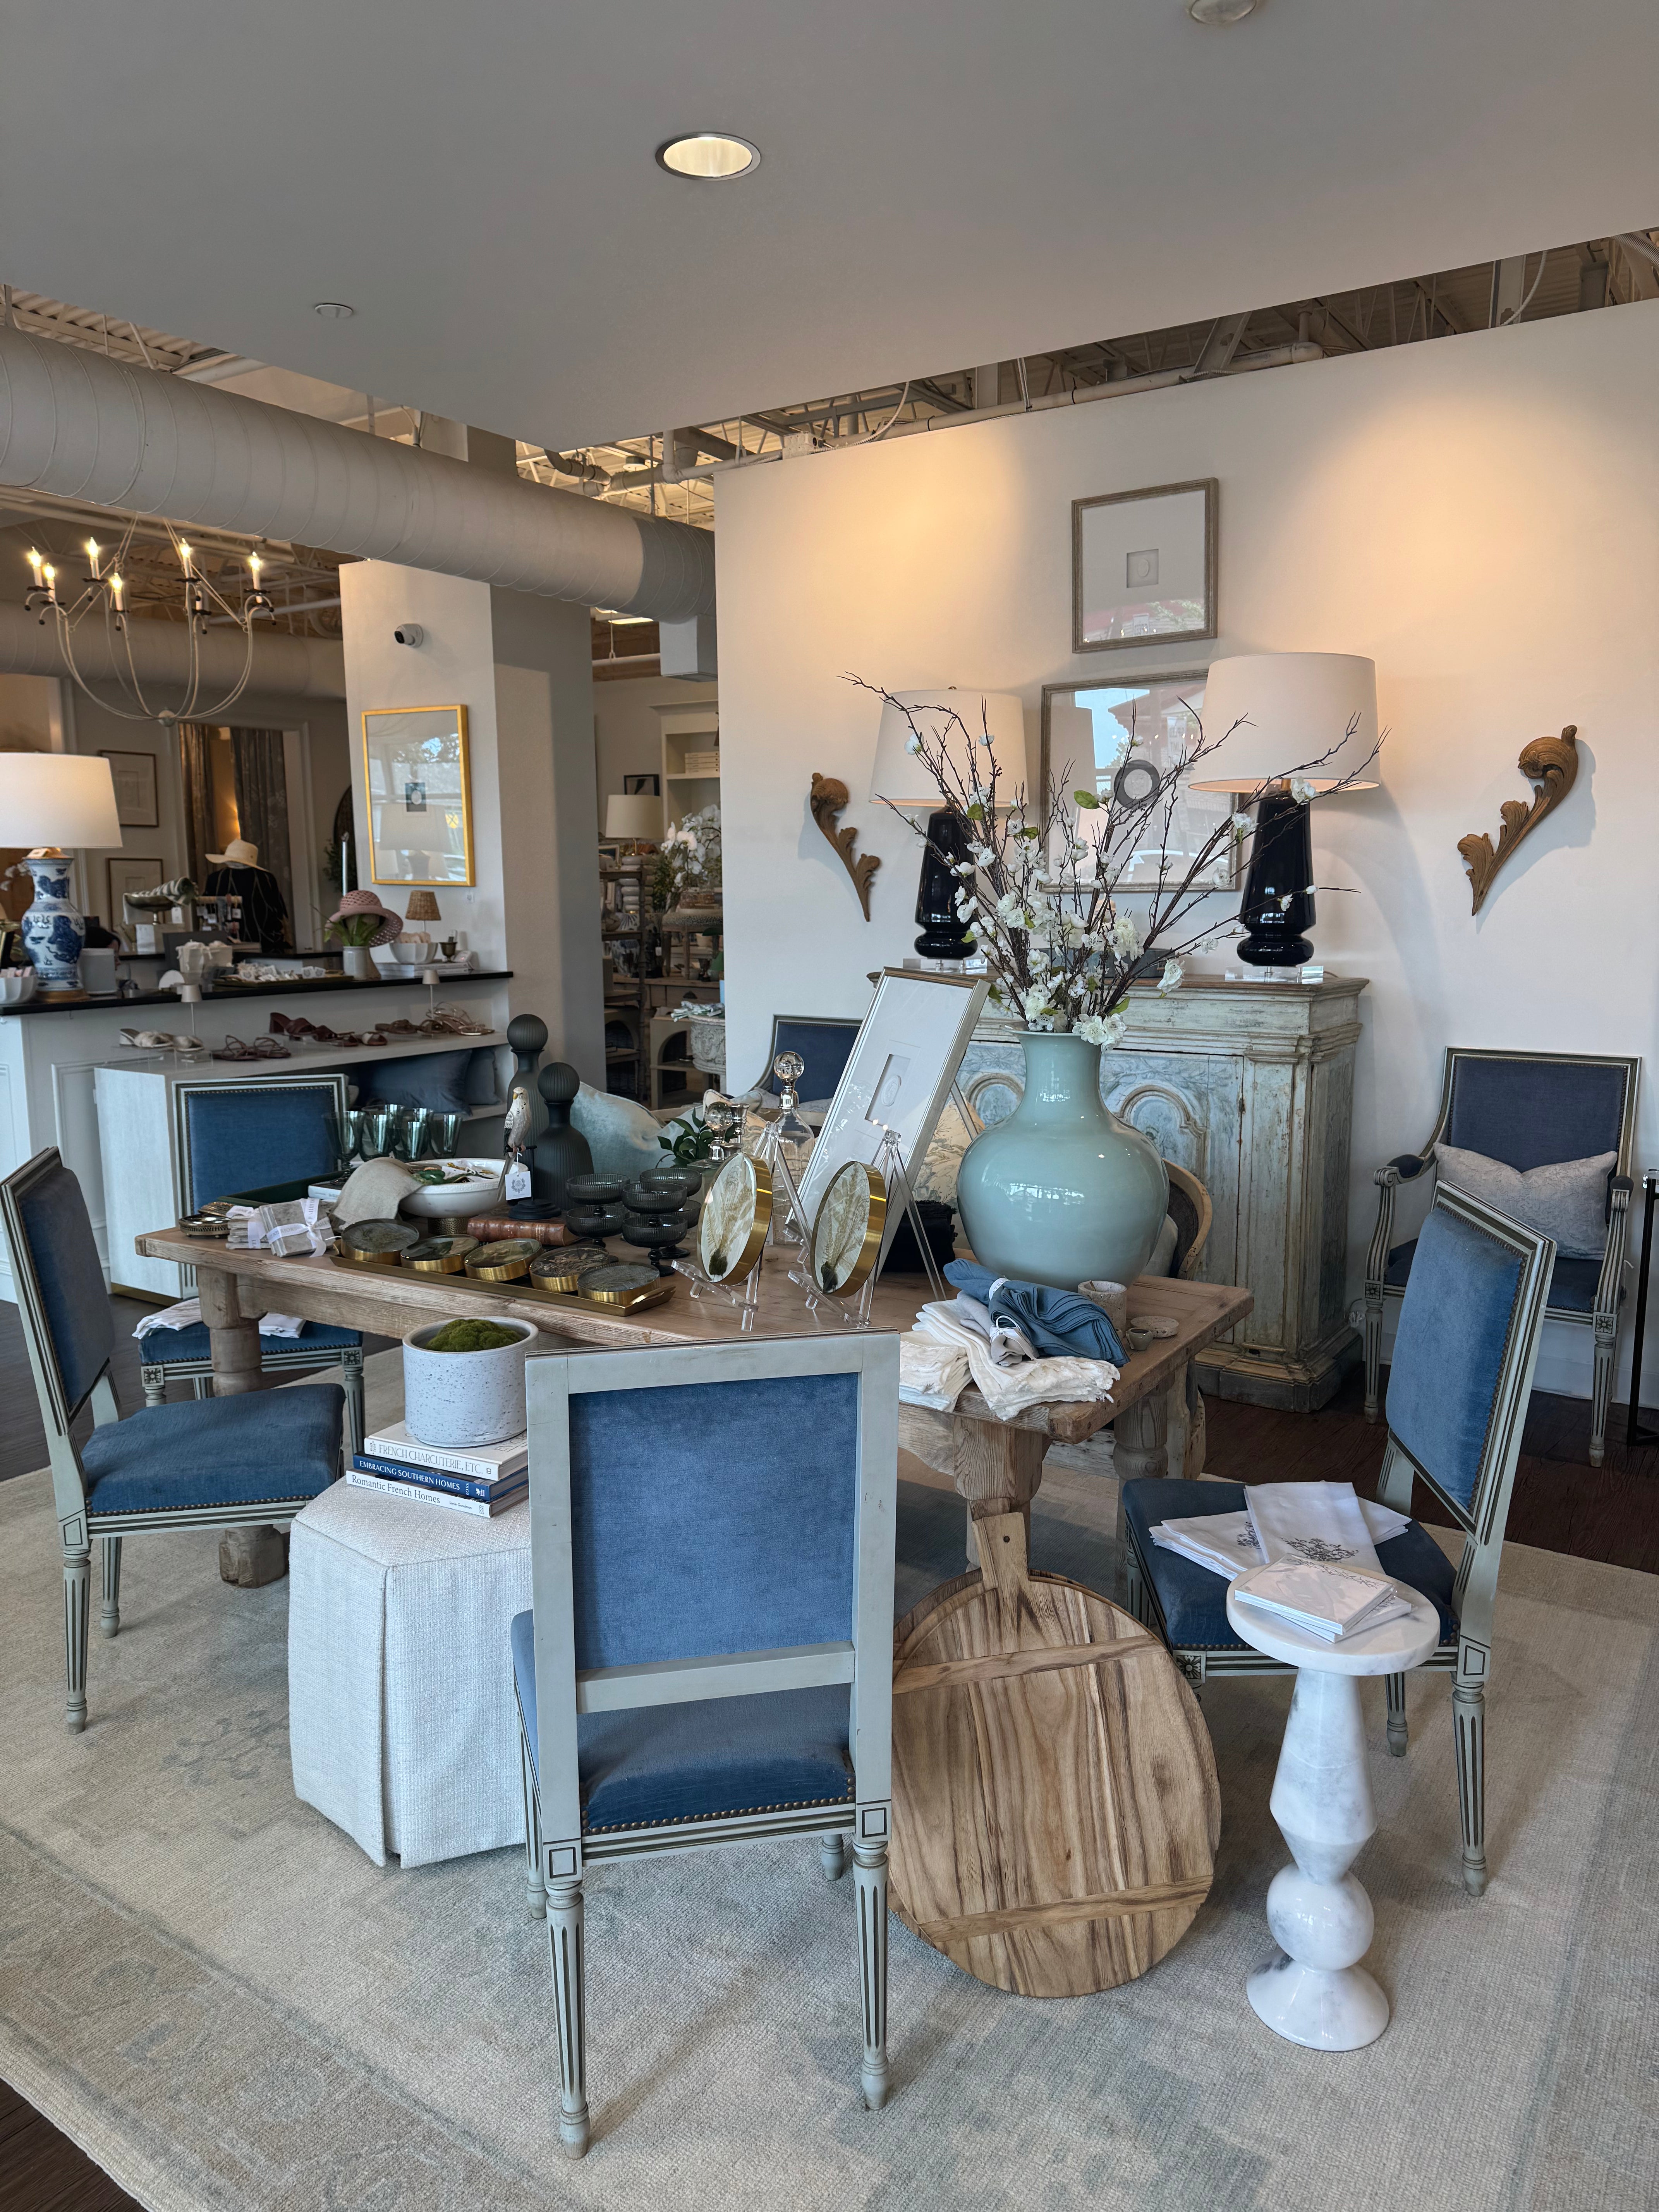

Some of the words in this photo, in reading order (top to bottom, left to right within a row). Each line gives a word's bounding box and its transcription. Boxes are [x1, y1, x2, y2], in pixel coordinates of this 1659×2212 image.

[379, 1444, 407, 1458] FRENCH
[409, 1451, 463, 1471] CHARCUTERIE,
[465, 1462, 483, 1474] ETC.
[352, 1475, 385, 1490] Romantic
[388, 1483, 412, 1496] French
[414, 1490, 440, 1503] Homes
[359, 1460, 397, 1475] EMBRACING
[398, 1470, 434, 1484] SOUTHERN
[436, 1479, 460, 1490] HOMES
